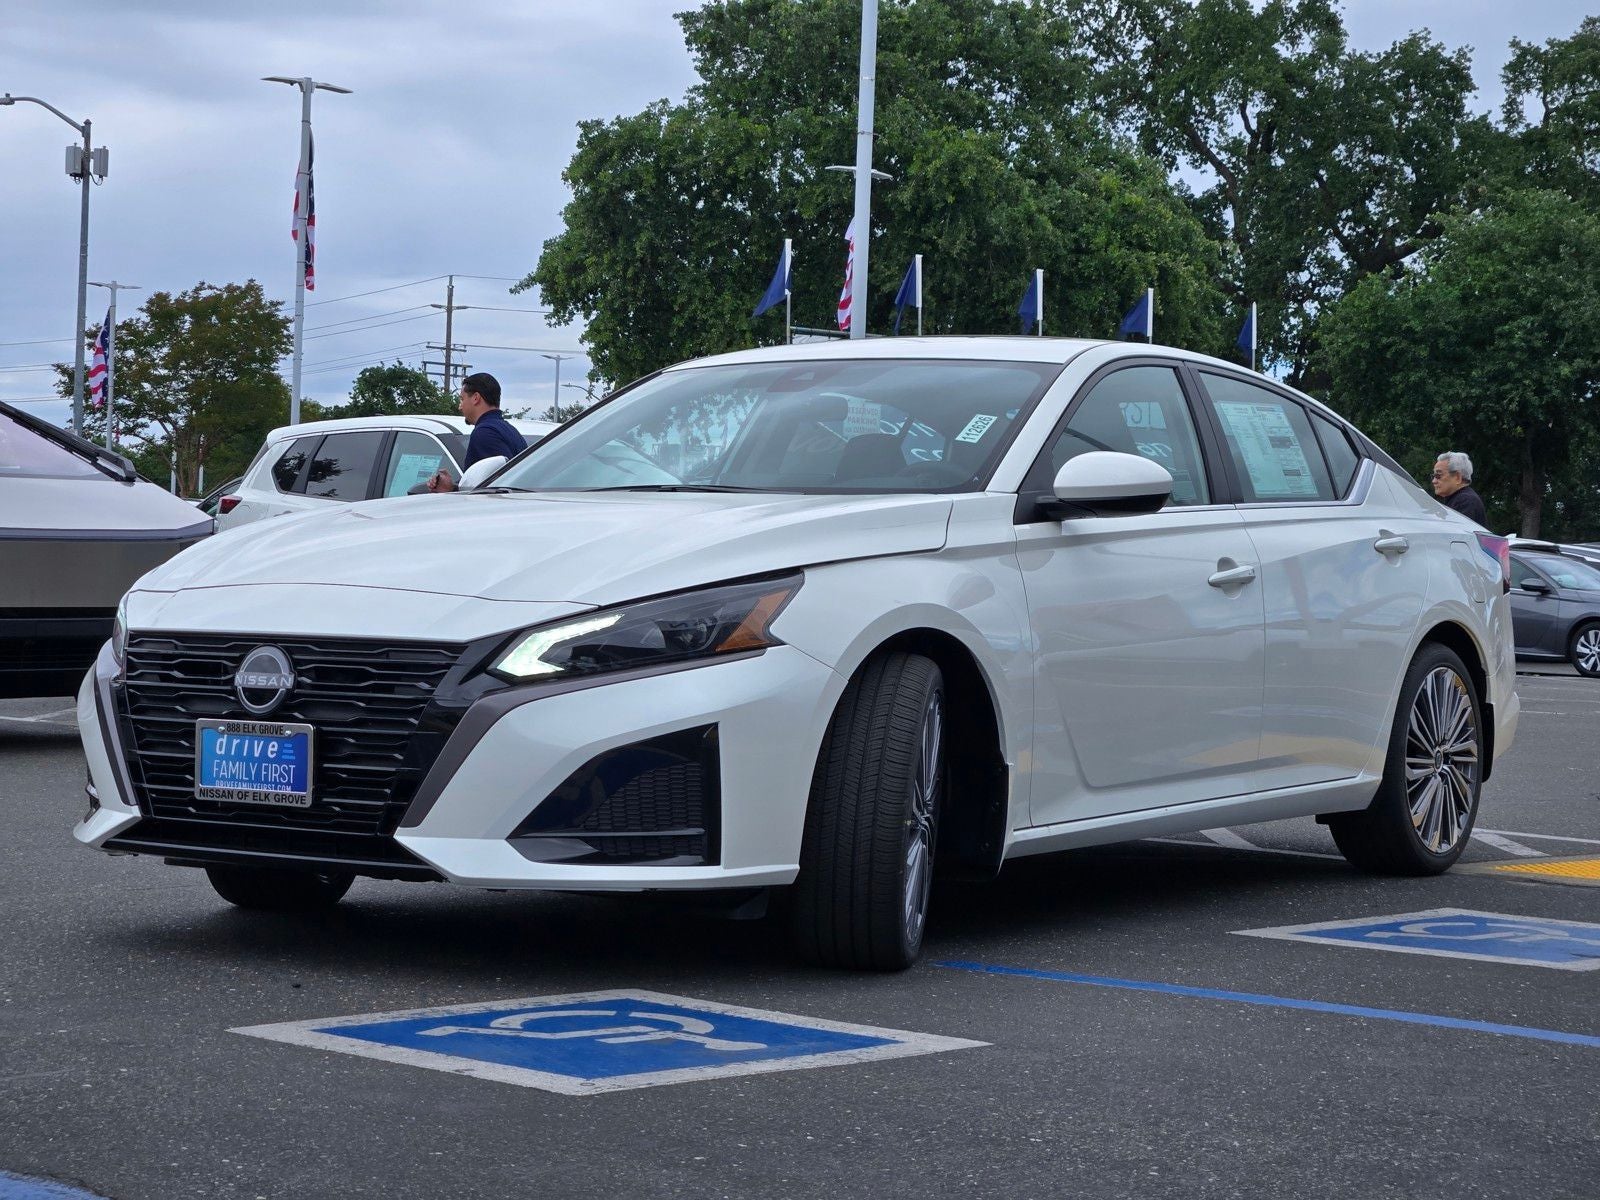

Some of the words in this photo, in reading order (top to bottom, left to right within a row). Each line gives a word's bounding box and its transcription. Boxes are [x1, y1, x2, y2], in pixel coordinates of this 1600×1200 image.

[961, 416, 992, 440] 112626
[235, 674, 292, 687] NISSAN
[226, 722, 240, 733] 888
[243, 723, 257, 734] ELK
[260, 724, 284, 736] GROVE
[216, 734, 279, 758] drive
[213, 760, 258, 781] FAMILY
[261, 763, 296, 784] FIRST
[200, 788, 234, 800] NISSAN
[237, 790, 250, 801] OF
[252, 792, 271, 802] ELK
[274, 793, 307, 805] GROVE
